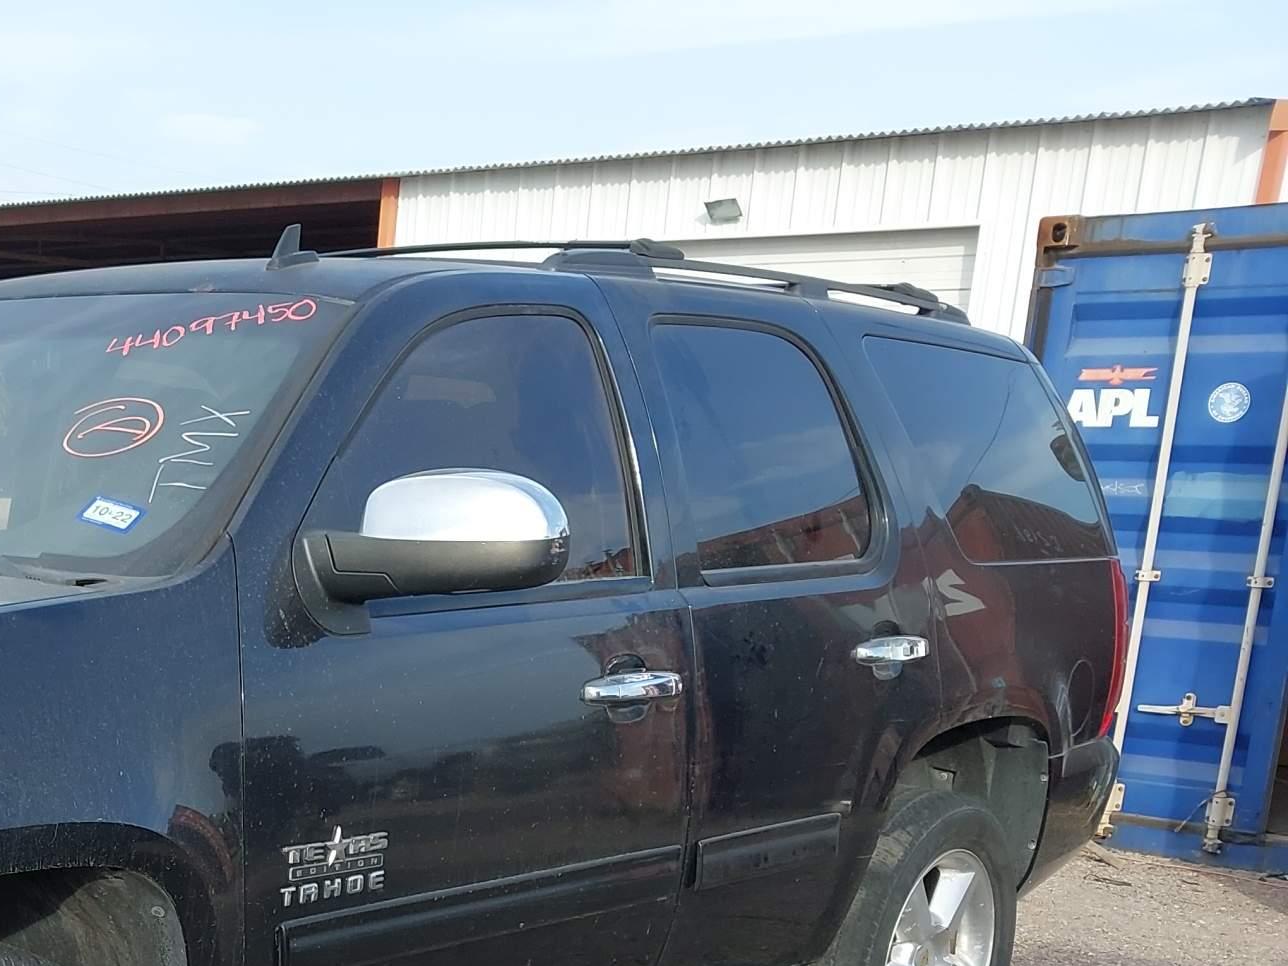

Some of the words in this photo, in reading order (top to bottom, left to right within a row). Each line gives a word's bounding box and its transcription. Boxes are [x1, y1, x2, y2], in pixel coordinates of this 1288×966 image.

[106, 298, 317, 355] 44097450
[1066, 388, 1160, 428] APL
[281, 825, 389, 865] TEXAS
[279, 870, 386, 907] TAHOE
